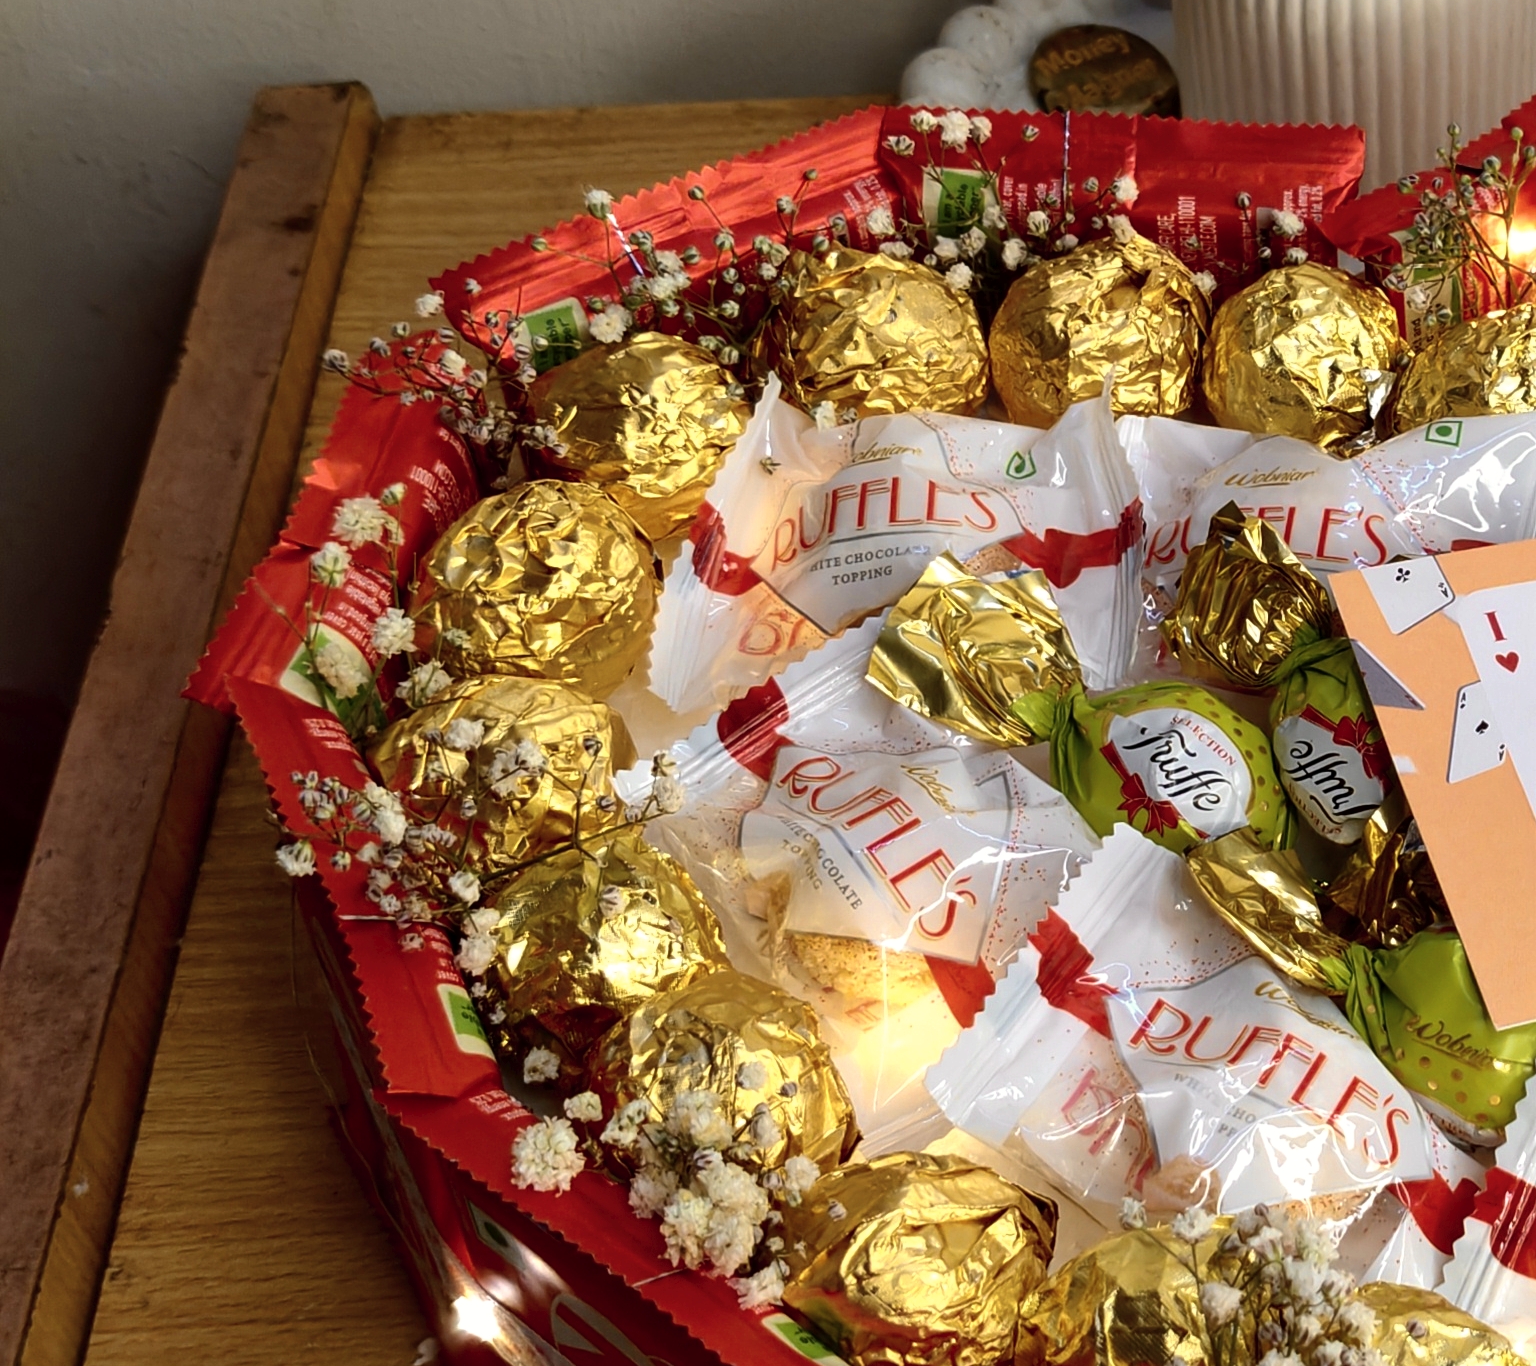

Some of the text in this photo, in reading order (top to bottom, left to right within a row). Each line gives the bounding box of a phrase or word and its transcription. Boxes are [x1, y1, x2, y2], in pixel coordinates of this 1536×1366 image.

[832, 565, 893, 586] TOPPING
[1122, 726, 1231, 812] Truffe
[1170, 715, 1237, 767] SELECTION
[1285, 740, 1380, 825] Truffe
[776, 755, 977, 940] RUFFLE'S
[1127, 997, 1410, 1168] RUFFLE'S
